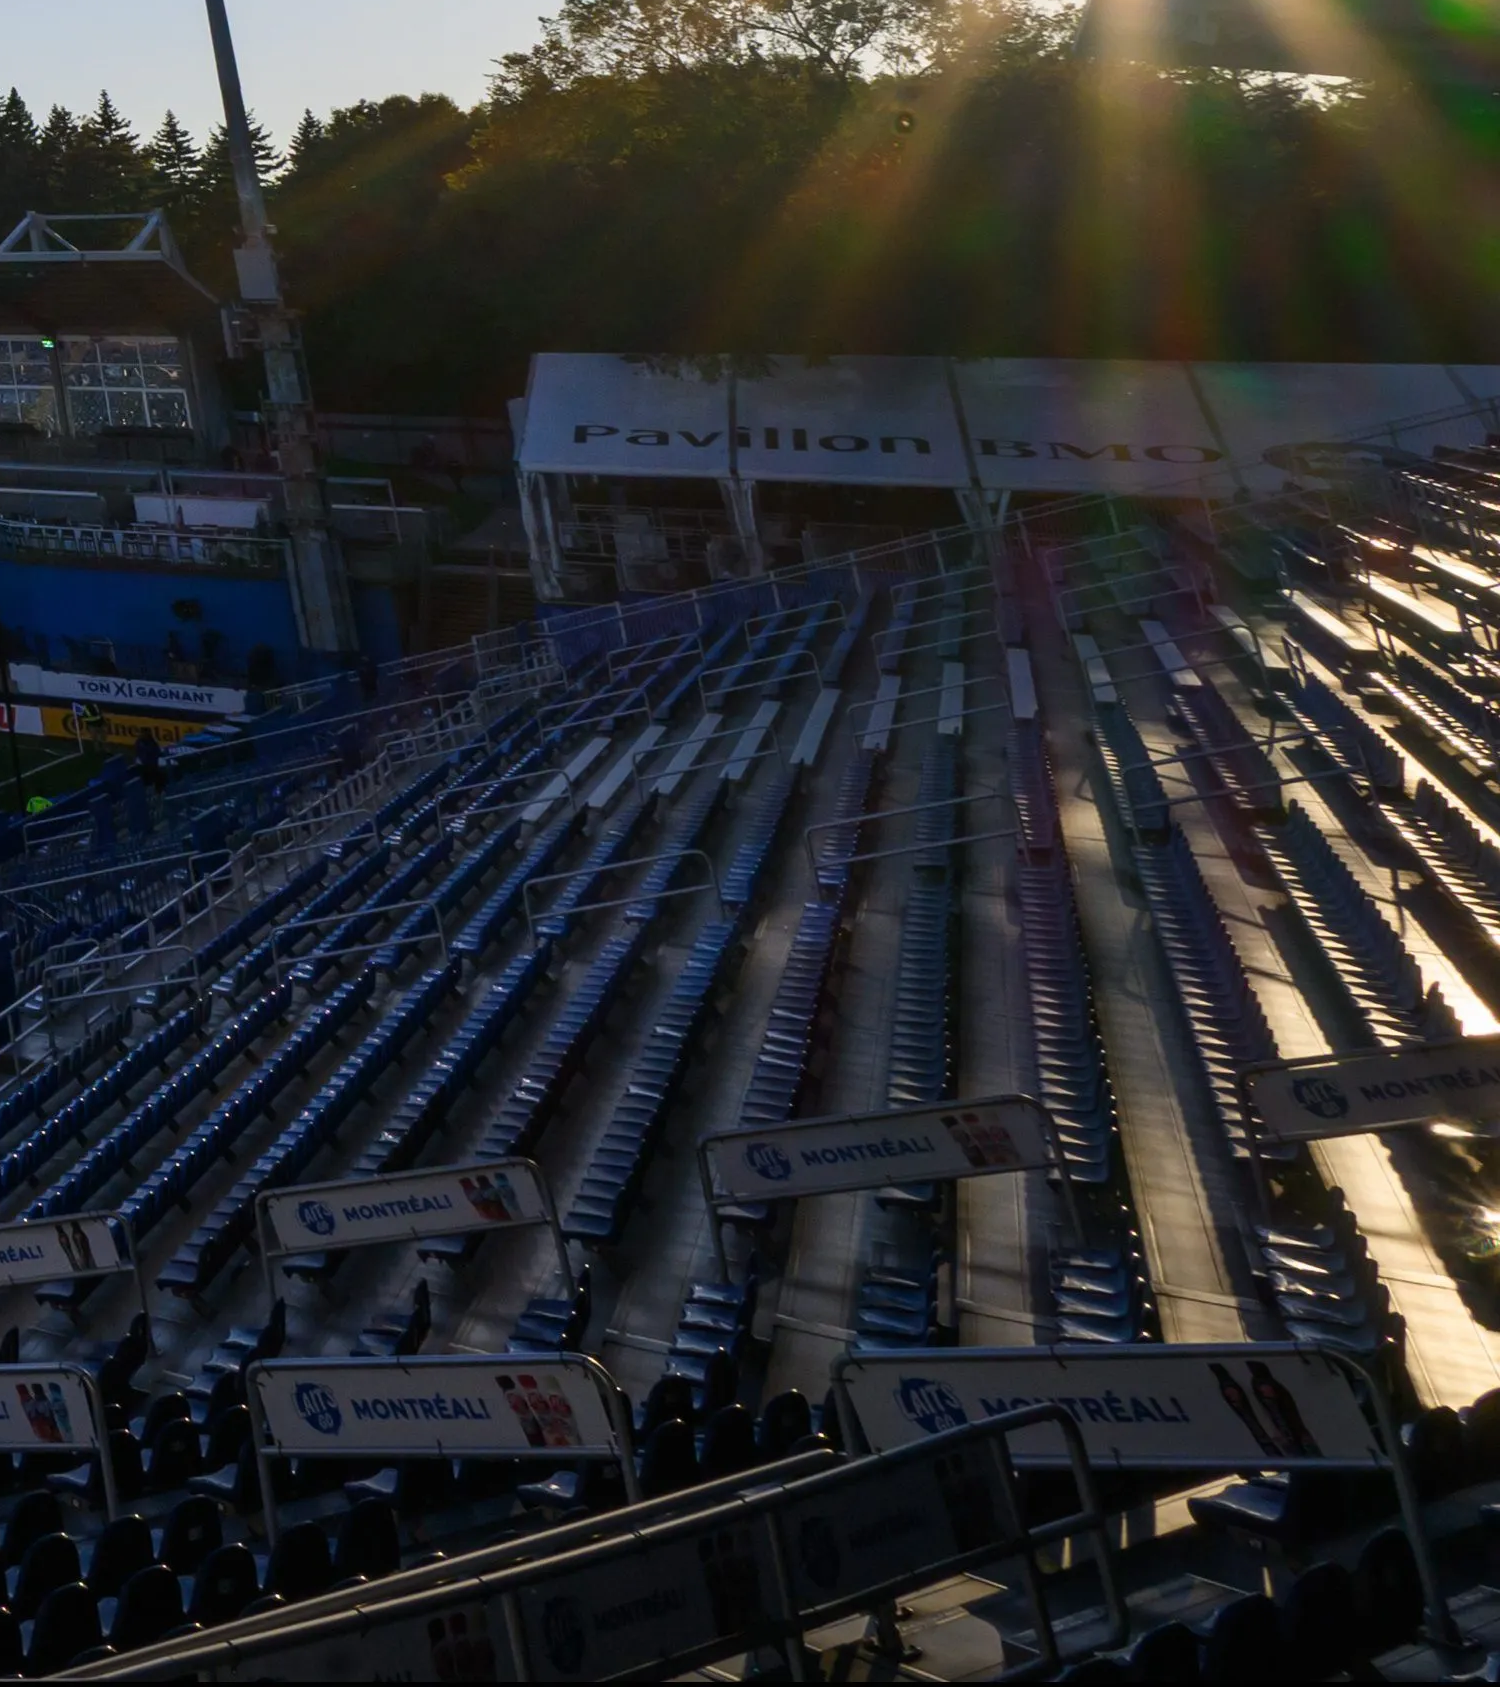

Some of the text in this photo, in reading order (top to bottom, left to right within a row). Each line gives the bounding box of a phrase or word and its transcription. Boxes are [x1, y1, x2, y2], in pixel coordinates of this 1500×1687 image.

[573, 424, 1223, 463] Pavillon BMO
[78, 680, 108, 694] TON
[136, 686, 214, 704] GAGNANT
[800, 1136, 936, 1168] MONTRÉAL!
[342, 1194, 453, 1222] MONTRÉAL!
[351, 1392, 493, 1420] MONTRÉAL!
[980, 1390, 1190, 1423] MTRÉAL!
